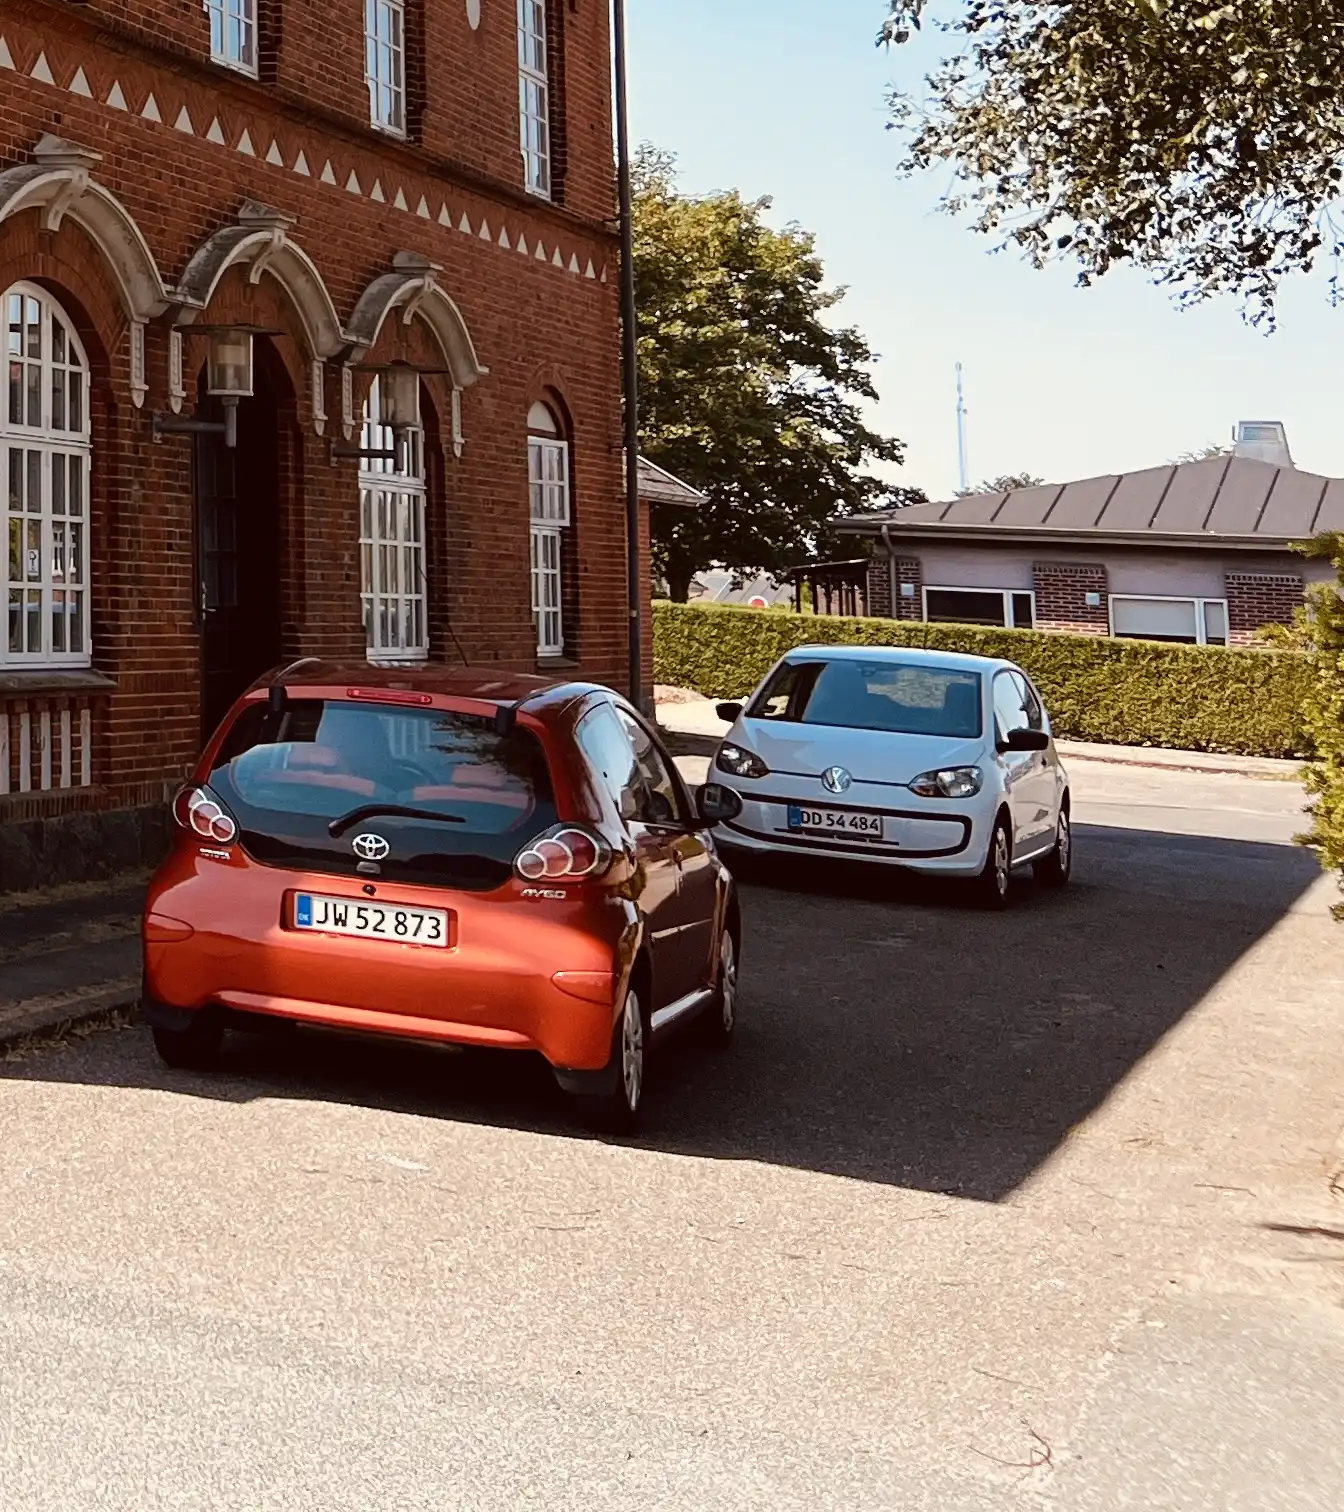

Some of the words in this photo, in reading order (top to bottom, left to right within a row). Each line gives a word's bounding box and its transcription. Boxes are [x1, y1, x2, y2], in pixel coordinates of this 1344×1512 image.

[800, 810, 823, 826] DD
[826, 813, 846, 829] 54
[849, 815, 880, 832] 484
[316, 901, 349, 928] JW
[355, 906, 386, 934] 52
[393, 910, 442, 940] 873
